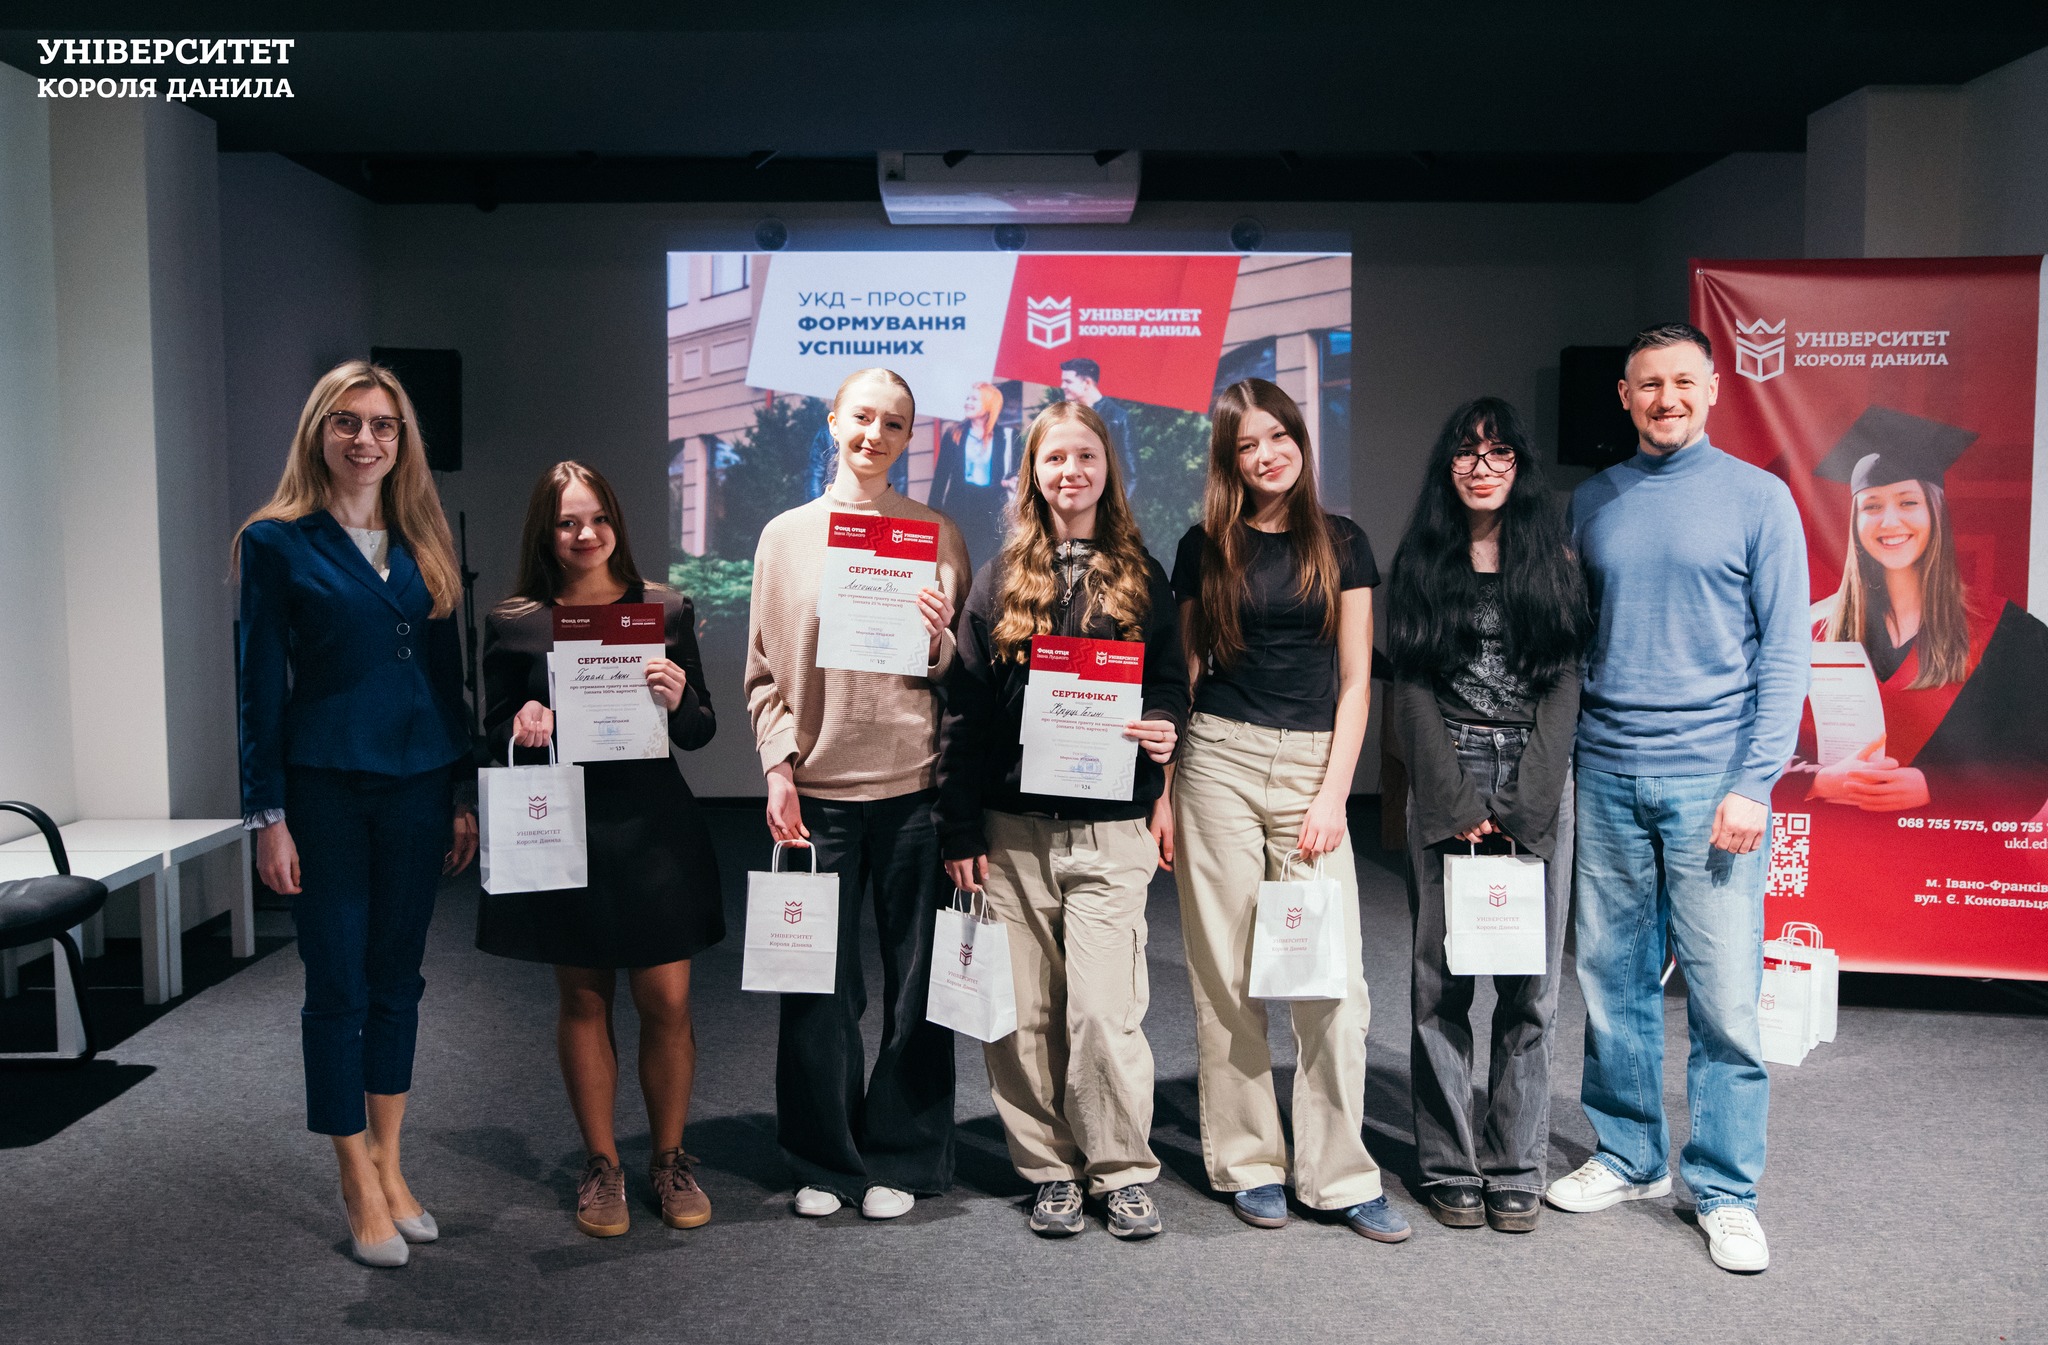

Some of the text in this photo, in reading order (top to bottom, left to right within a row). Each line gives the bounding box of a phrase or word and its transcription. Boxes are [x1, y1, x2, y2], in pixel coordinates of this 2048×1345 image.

[798, 292, 845, 309] УКД
[868, 291, 966, 307] ПРОСТІР
[1078, 308, 1202, 322] УНІВЕРСИТЕТ
[798, 316, 966, 331] ФОРМУВАННЯ
[1078, 325, 1202, 338] КОРОЛЯ ДАНИЛА
[1795, 331, 1949, 348] УНІВЕРСИТЕТ
[798, 341, 924, 355] УСПІШНИХ
[1794, 353, 1949, 368] КОРОЛЯ ДАНИЛА
[848, 565, 913, 579] СЕРТИФІКАТ
[577, 656, 642, 664] СЕРТИФІКАТ
[1052, 690, 1118, 702] СЕРТИФІКАТ
[1897, 817, 1924, 828] 068
[1927, 819, 1950, 829] 755
[1953, 820, 1988, 833] 7575,
[1992, 821, 2018, 832] 099
[2020, 822, 2043, 832] 755
[517, 829, 561, 837] УНІВЕРСИТЕТ
[2004, 837, 2048, 849] ukd.ed
[1925, 879, 1941, 888] м.
[1914, 894, 1942, 906] вул.
[1946, 894, 1960, 904] Є.
